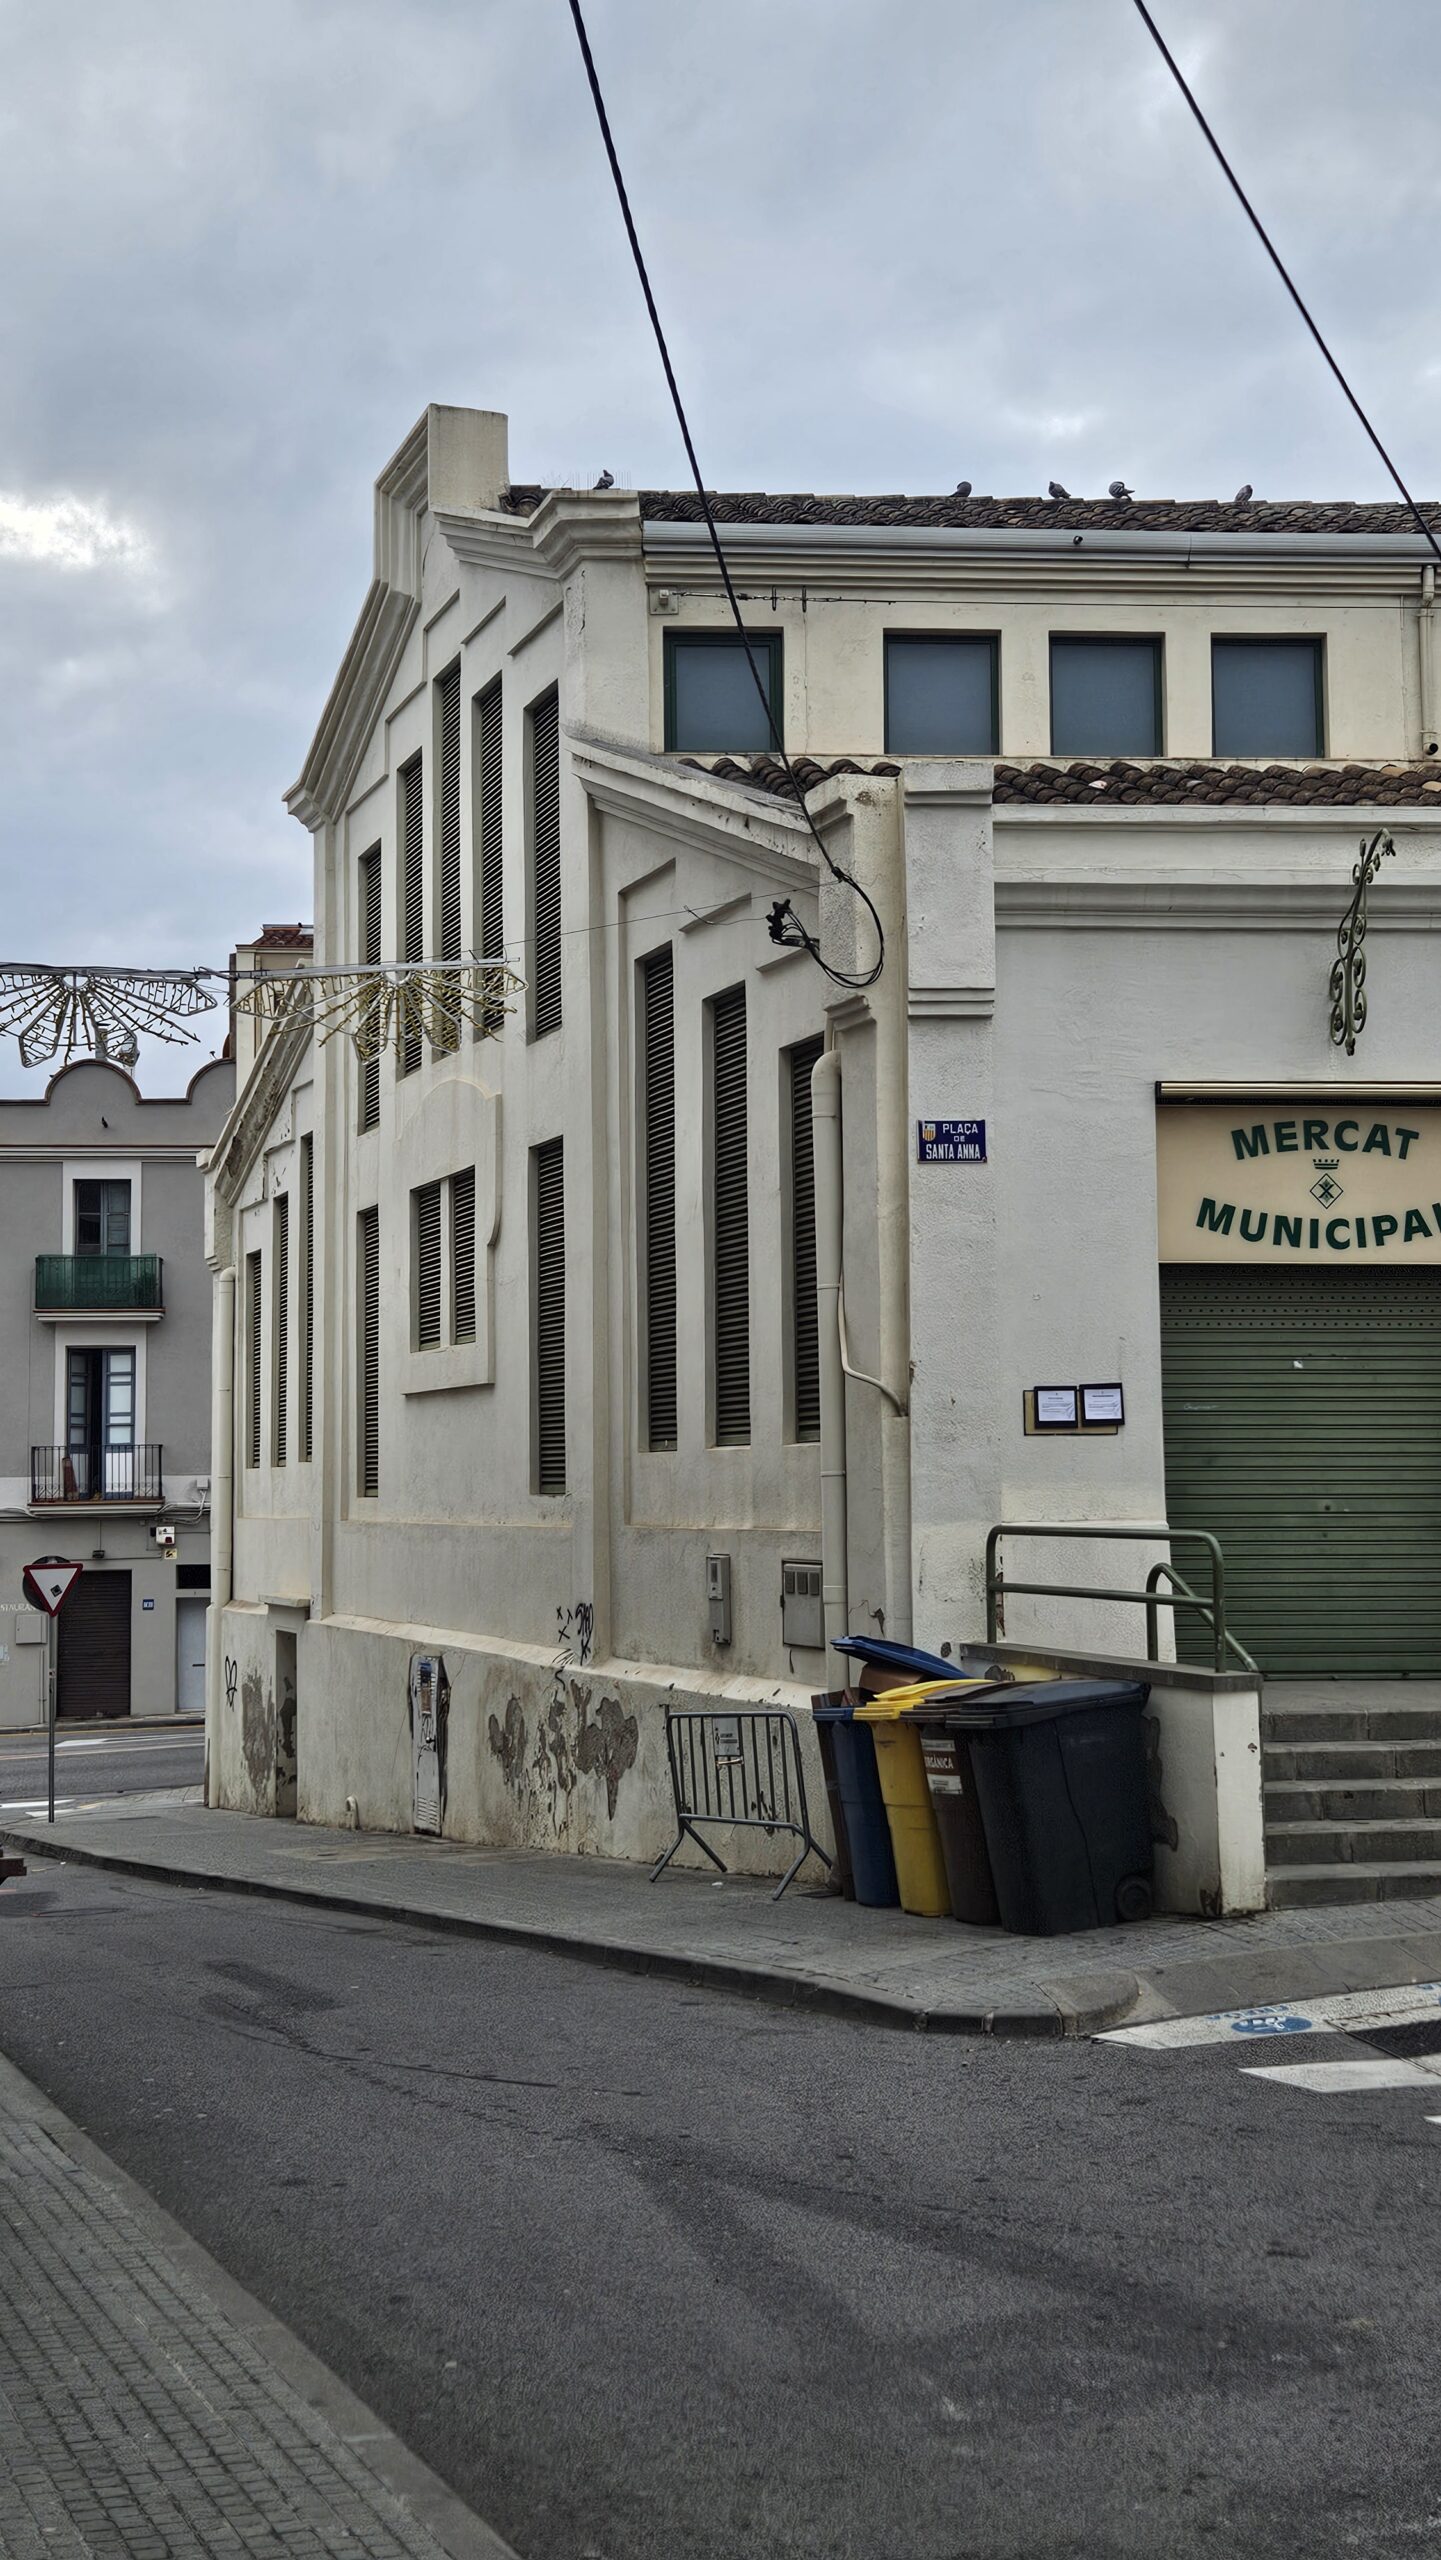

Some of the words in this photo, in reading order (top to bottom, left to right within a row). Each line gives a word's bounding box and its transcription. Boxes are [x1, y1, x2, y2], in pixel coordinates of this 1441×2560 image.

[943, 1124, 978, 1135] PLAÇA
[1231, 1119, 1420, 1160] MERCAT
[926, 1144, 955, 1159] SANTA
[957, 1144, 981, 1159] ANNA
